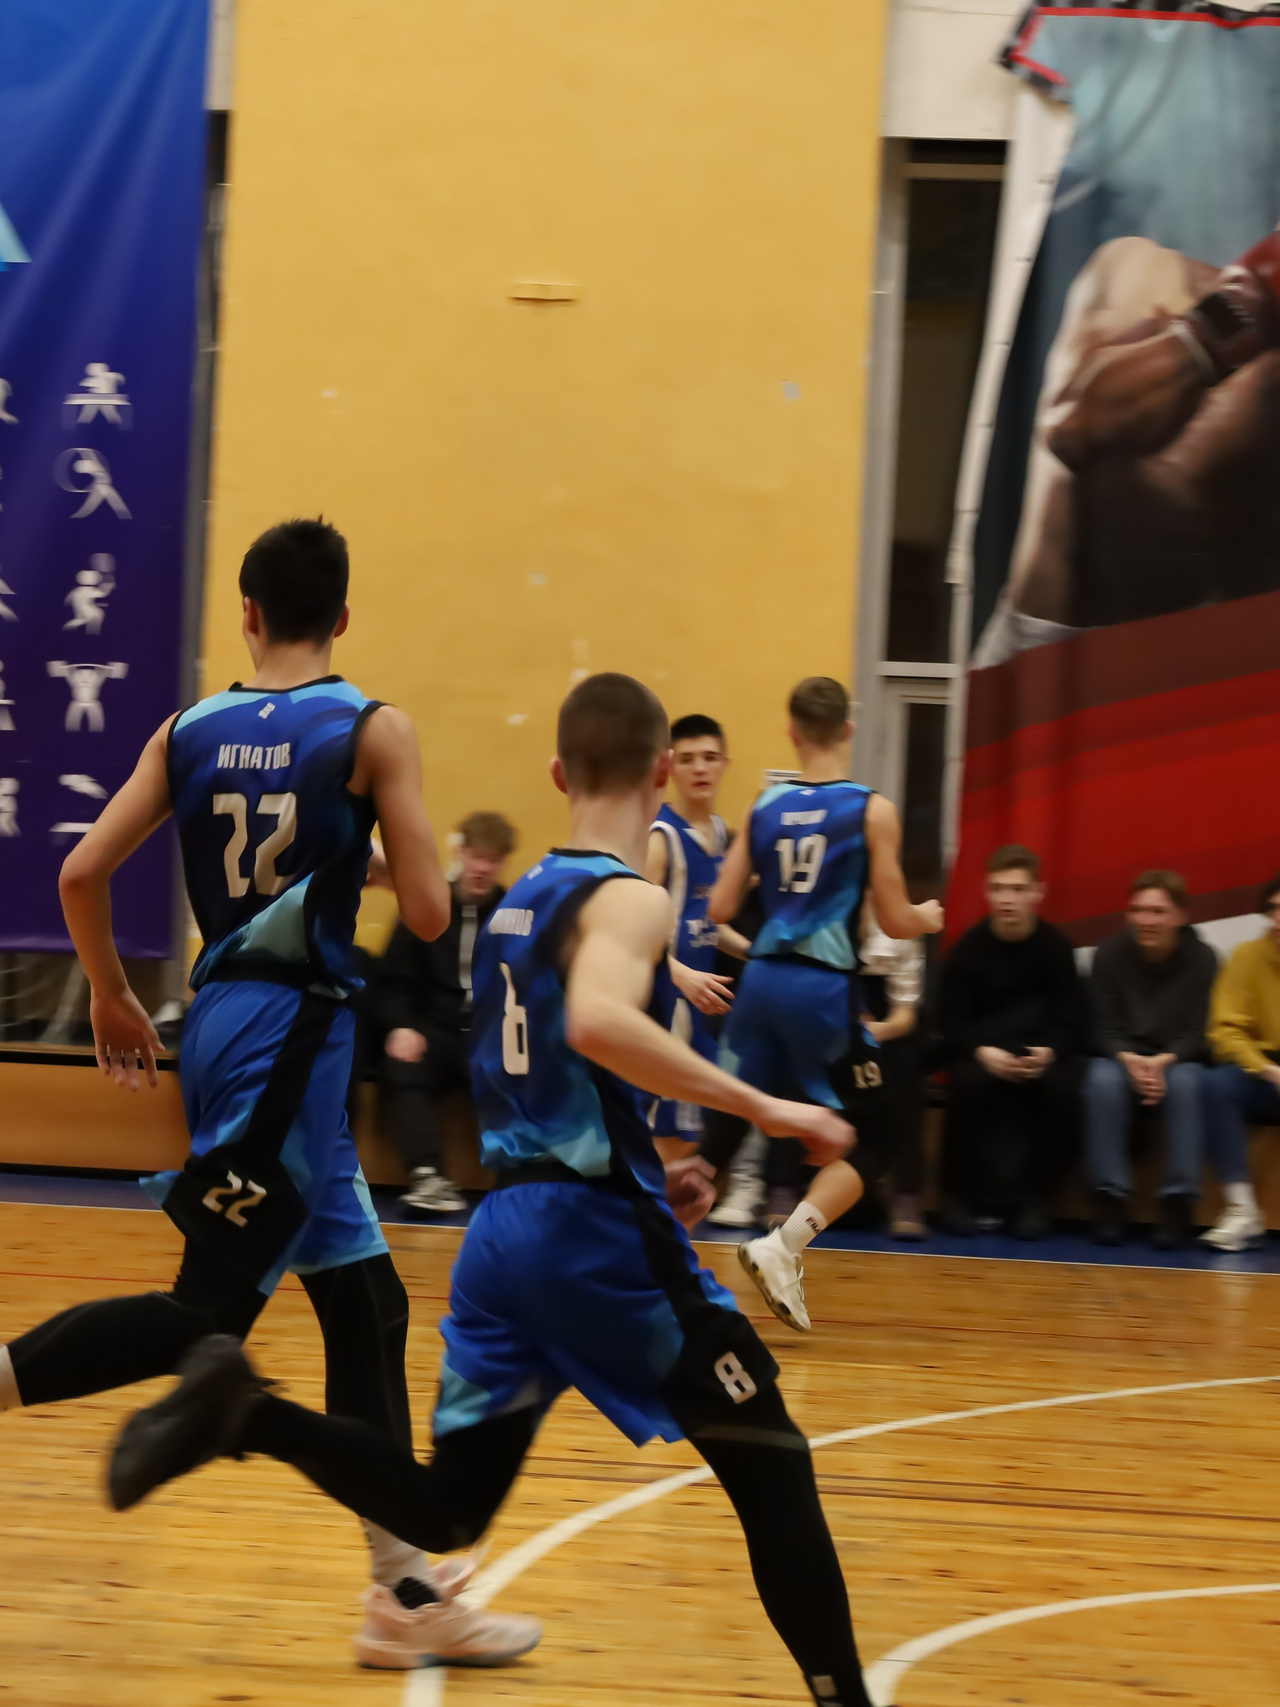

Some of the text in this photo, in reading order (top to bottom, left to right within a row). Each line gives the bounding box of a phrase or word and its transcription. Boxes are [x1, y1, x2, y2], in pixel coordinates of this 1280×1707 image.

[217, 742, 291, 770] ИГНАТОВ
[213, 791, 297, 899] 22
[774, 833, 828, 894] 19
[851, 1060, 883, 1089] 19
[202, 1169, 268, 1228] 22
[714, 1351, 758, 1405] 8
